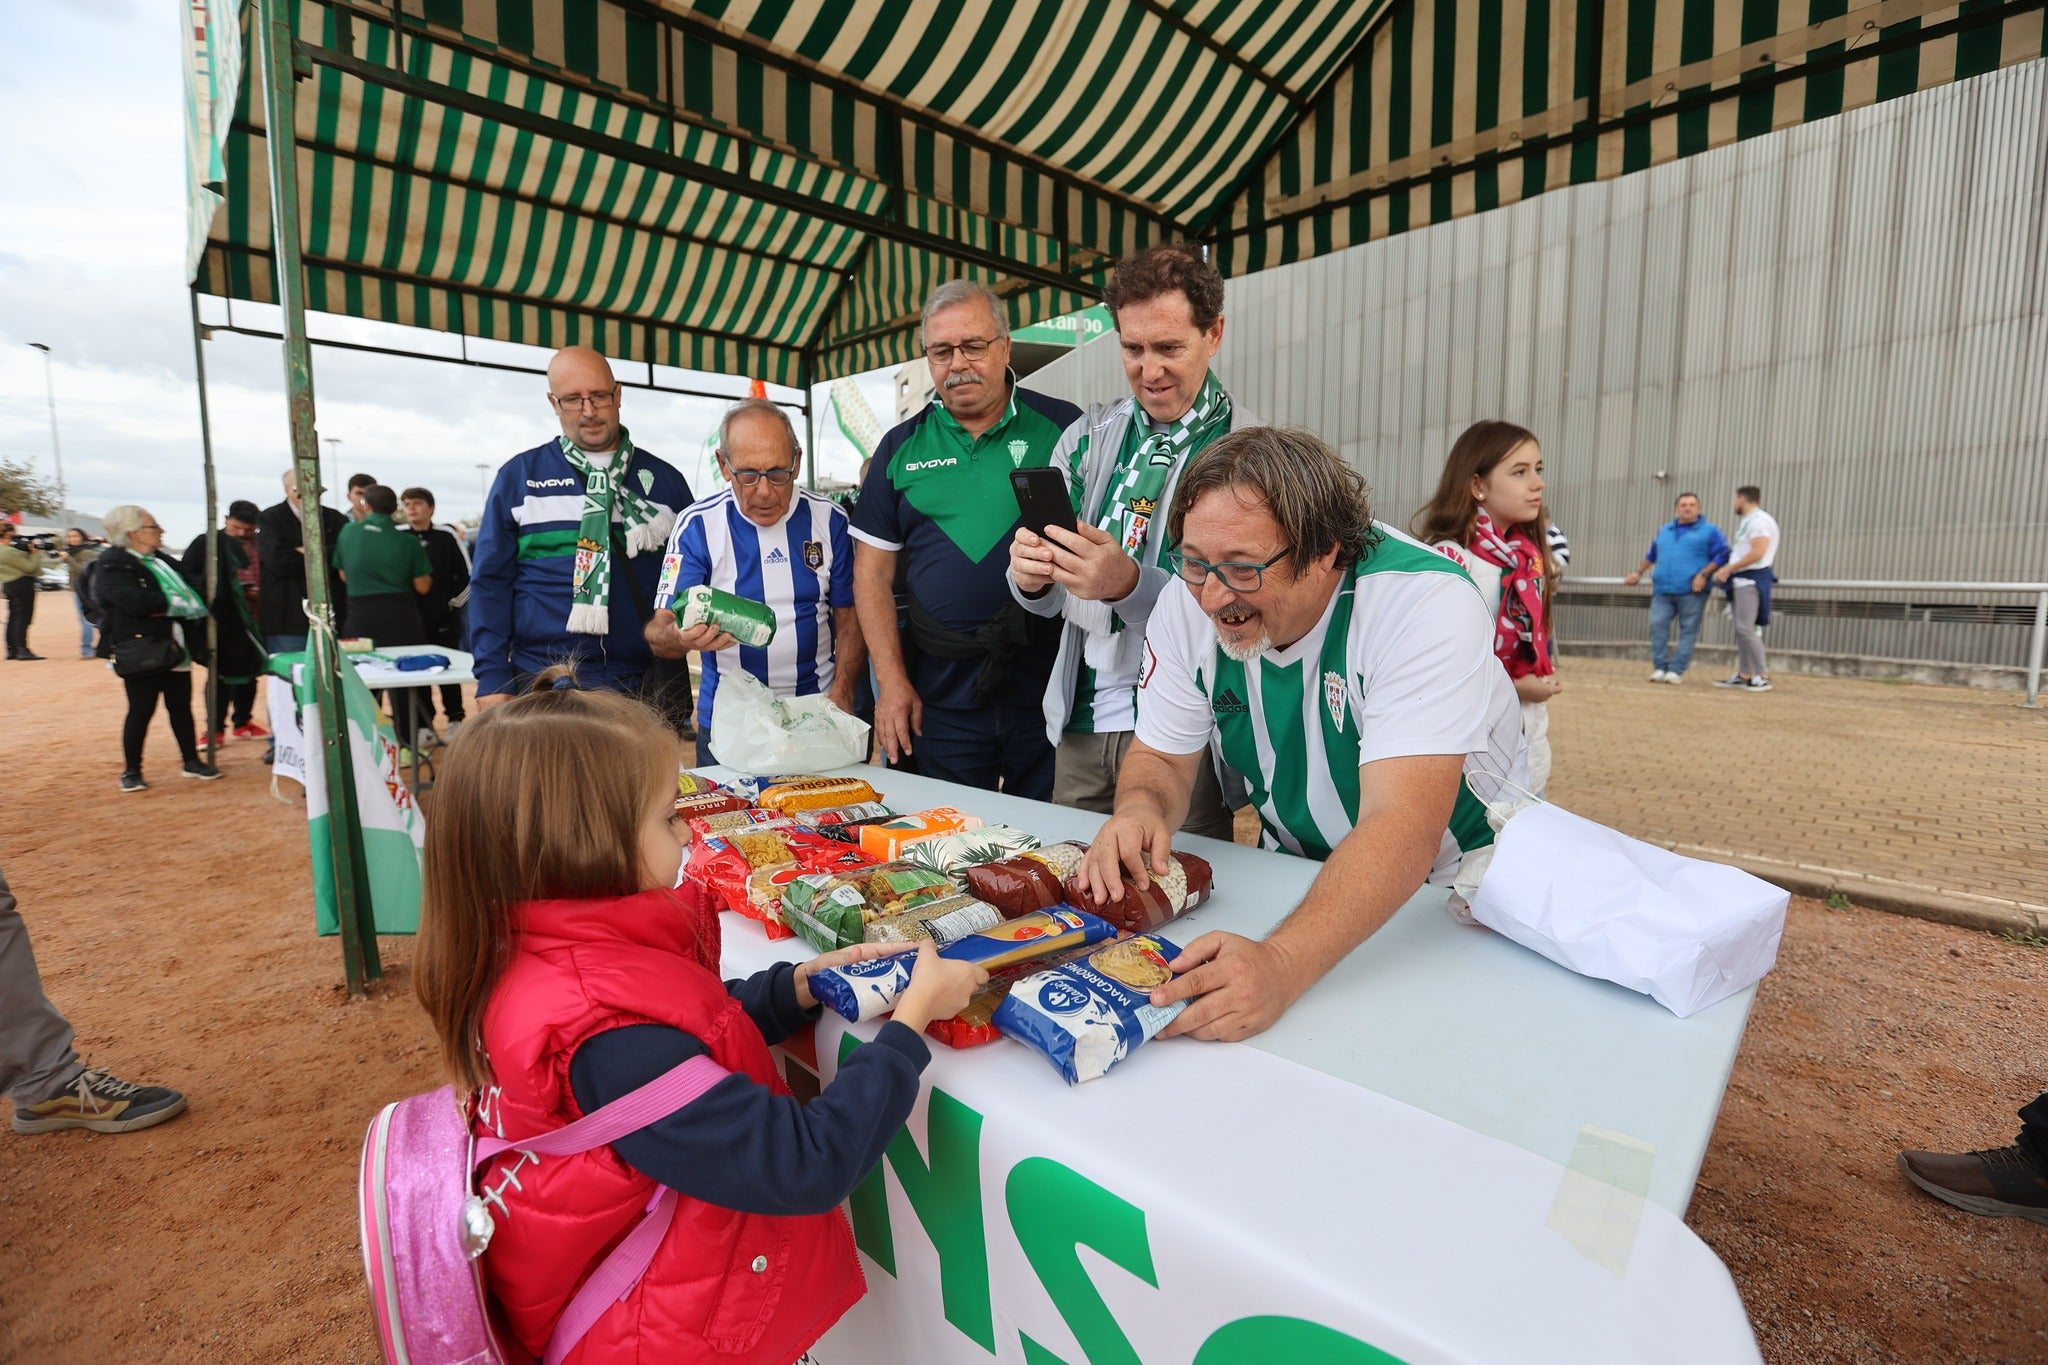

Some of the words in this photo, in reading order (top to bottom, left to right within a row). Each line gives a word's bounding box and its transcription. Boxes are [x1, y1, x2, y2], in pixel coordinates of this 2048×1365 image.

[906, 457, 957, 471] GIVOVA
[526, 477, 575, 489] GIVOVA
[763, 556, 788, 565] adidas
[1212, 703, 1249, 713] adidas
[693, 800, 727, 812] ARROZ
